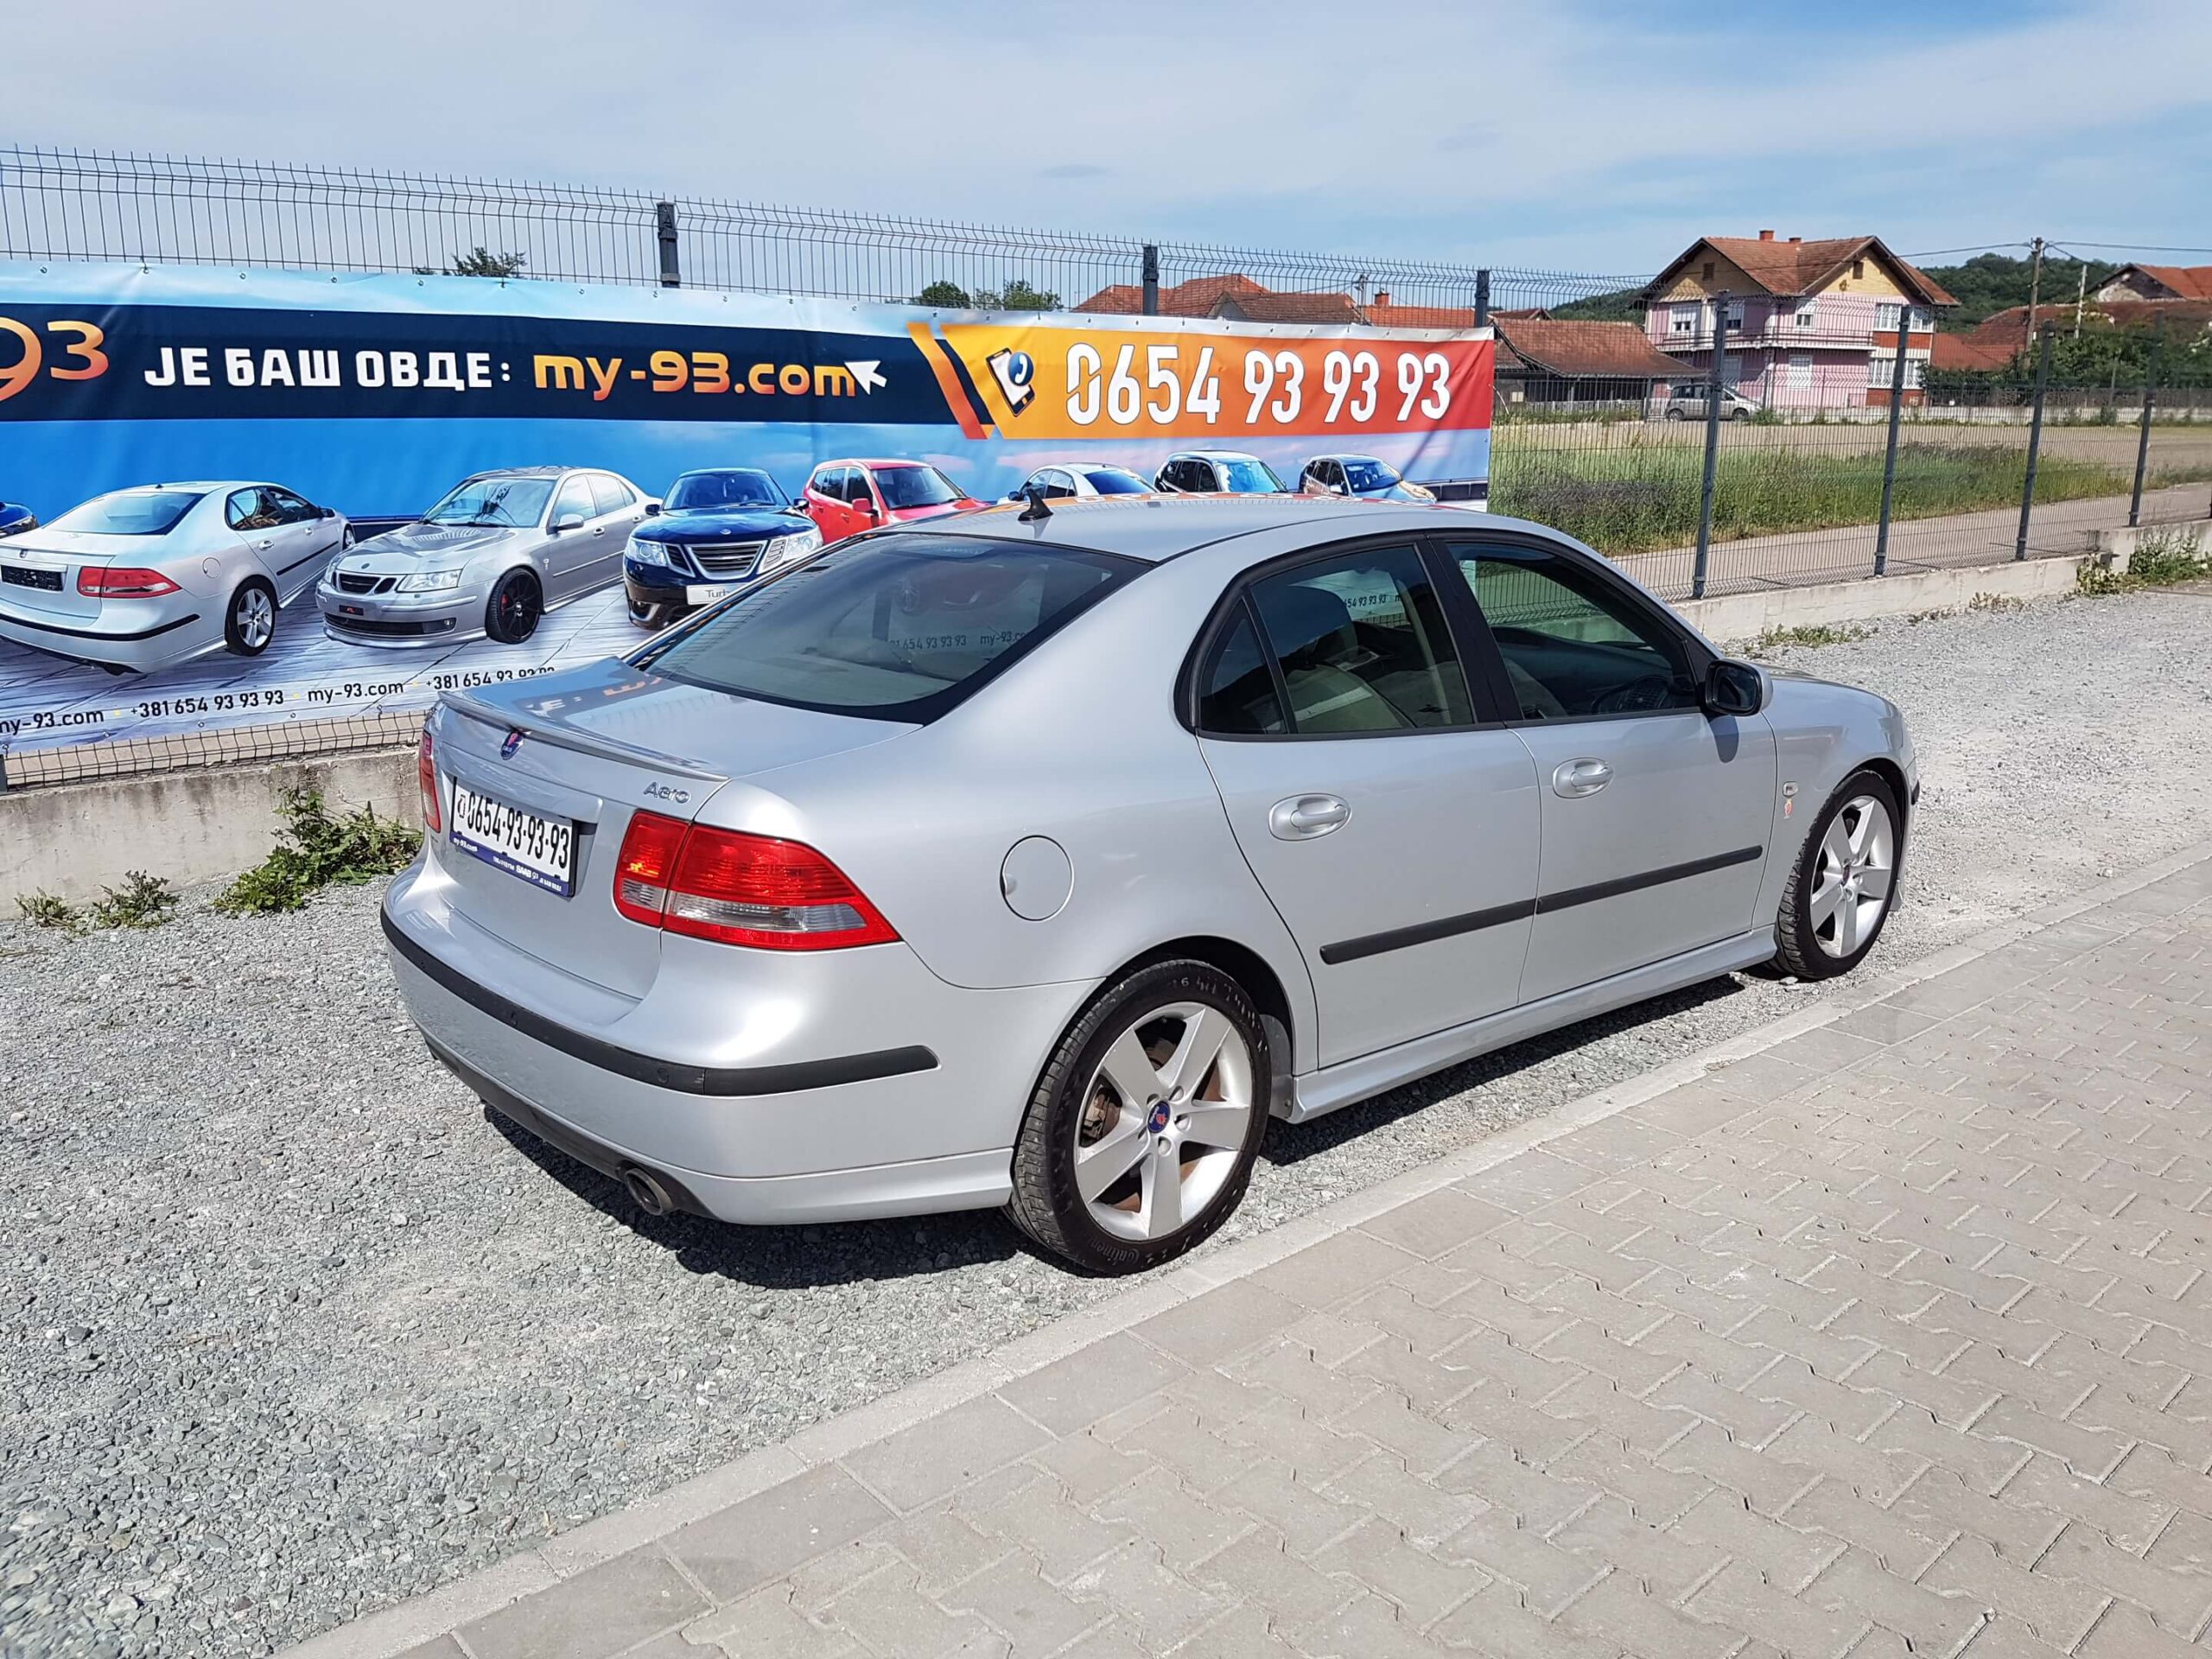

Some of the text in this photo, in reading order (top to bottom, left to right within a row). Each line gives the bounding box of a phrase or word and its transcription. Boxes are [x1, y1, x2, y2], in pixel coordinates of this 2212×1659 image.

[144, 347, 211, 386] ЈЕ
[225, 348, 341, 387] БАШ
[355, 350, 511, 391] ОВДЕ:
[533, 350, 856, 401] my-93.com
[1065, 342, 1452, 425] 0654 93 93 93
[925, 637, 937, 649] 93
[941, 635, 952, 648] 93
[955, 634, 967, 646] 93
[130, 700, 169, 719] +381
[175, 697, 208, 715] 654
[214, 695, 234, 711] 93
[239, 692, 259, 708] 93
[264, 690, 284, 705] 93
[308, 682, 404, 704] my-93.com
[426, 675, 458, 690] +381
[463, 672, 492, 687] 654
[643, 781, 691, 804] Aero
